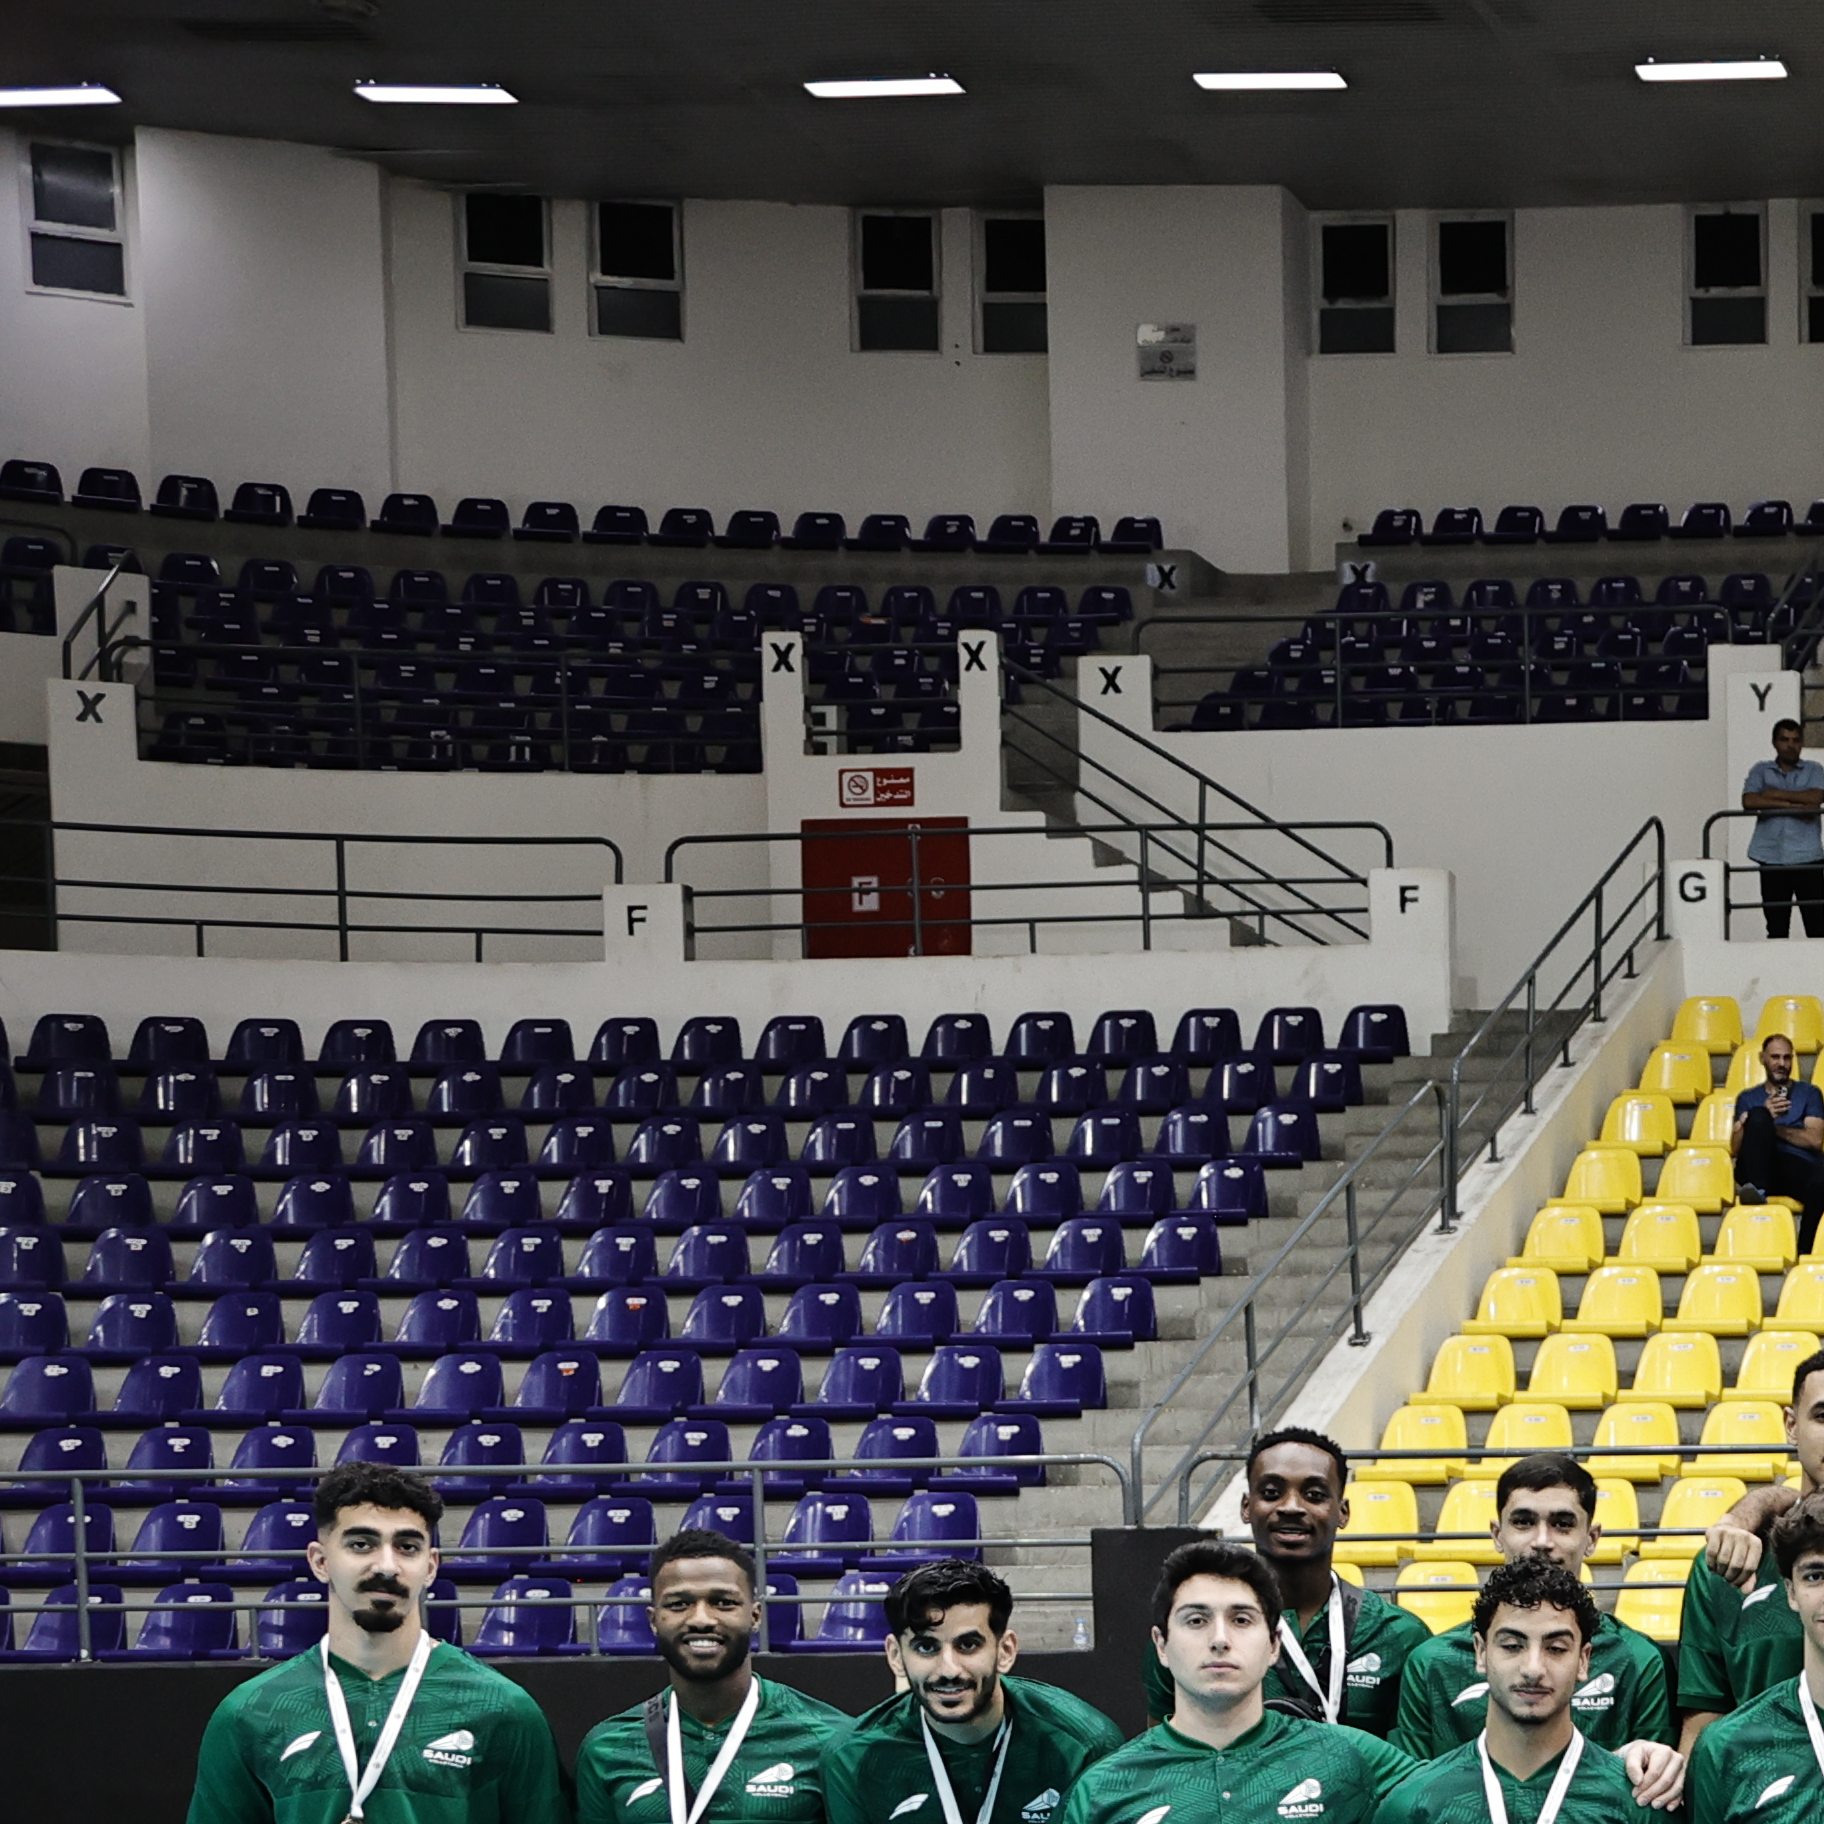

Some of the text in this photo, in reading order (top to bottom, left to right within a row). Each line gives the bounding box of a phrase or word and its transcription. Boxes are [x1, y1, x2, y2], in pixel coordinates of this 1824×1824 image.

[1156, 564, 1176, 589] X
[769, 642, 795, 673] X
[961, 641, 988, 672] X
[1098, 666, 1122, 695] X
[75, 689, 106, 723] X
[1749, 683, 1773, 712] Y
[858, 881, 873, 906] F
[1399, 885, 1419, 913] F
[1679, 871, 1707, 902] G
[627, 905, 647, 936] F
[1347, 1674, 1380, 1685] AUDI
[1571, 1697, 1614, 1706] SAUDI
[423, 1749, 472, 1765] SAUDI
[745, 1784, 794, 1794] SAUDI
[1021, 1811, 1050, 1820] SAU
[1277, 1803, 1324, 1815] SAUDI
